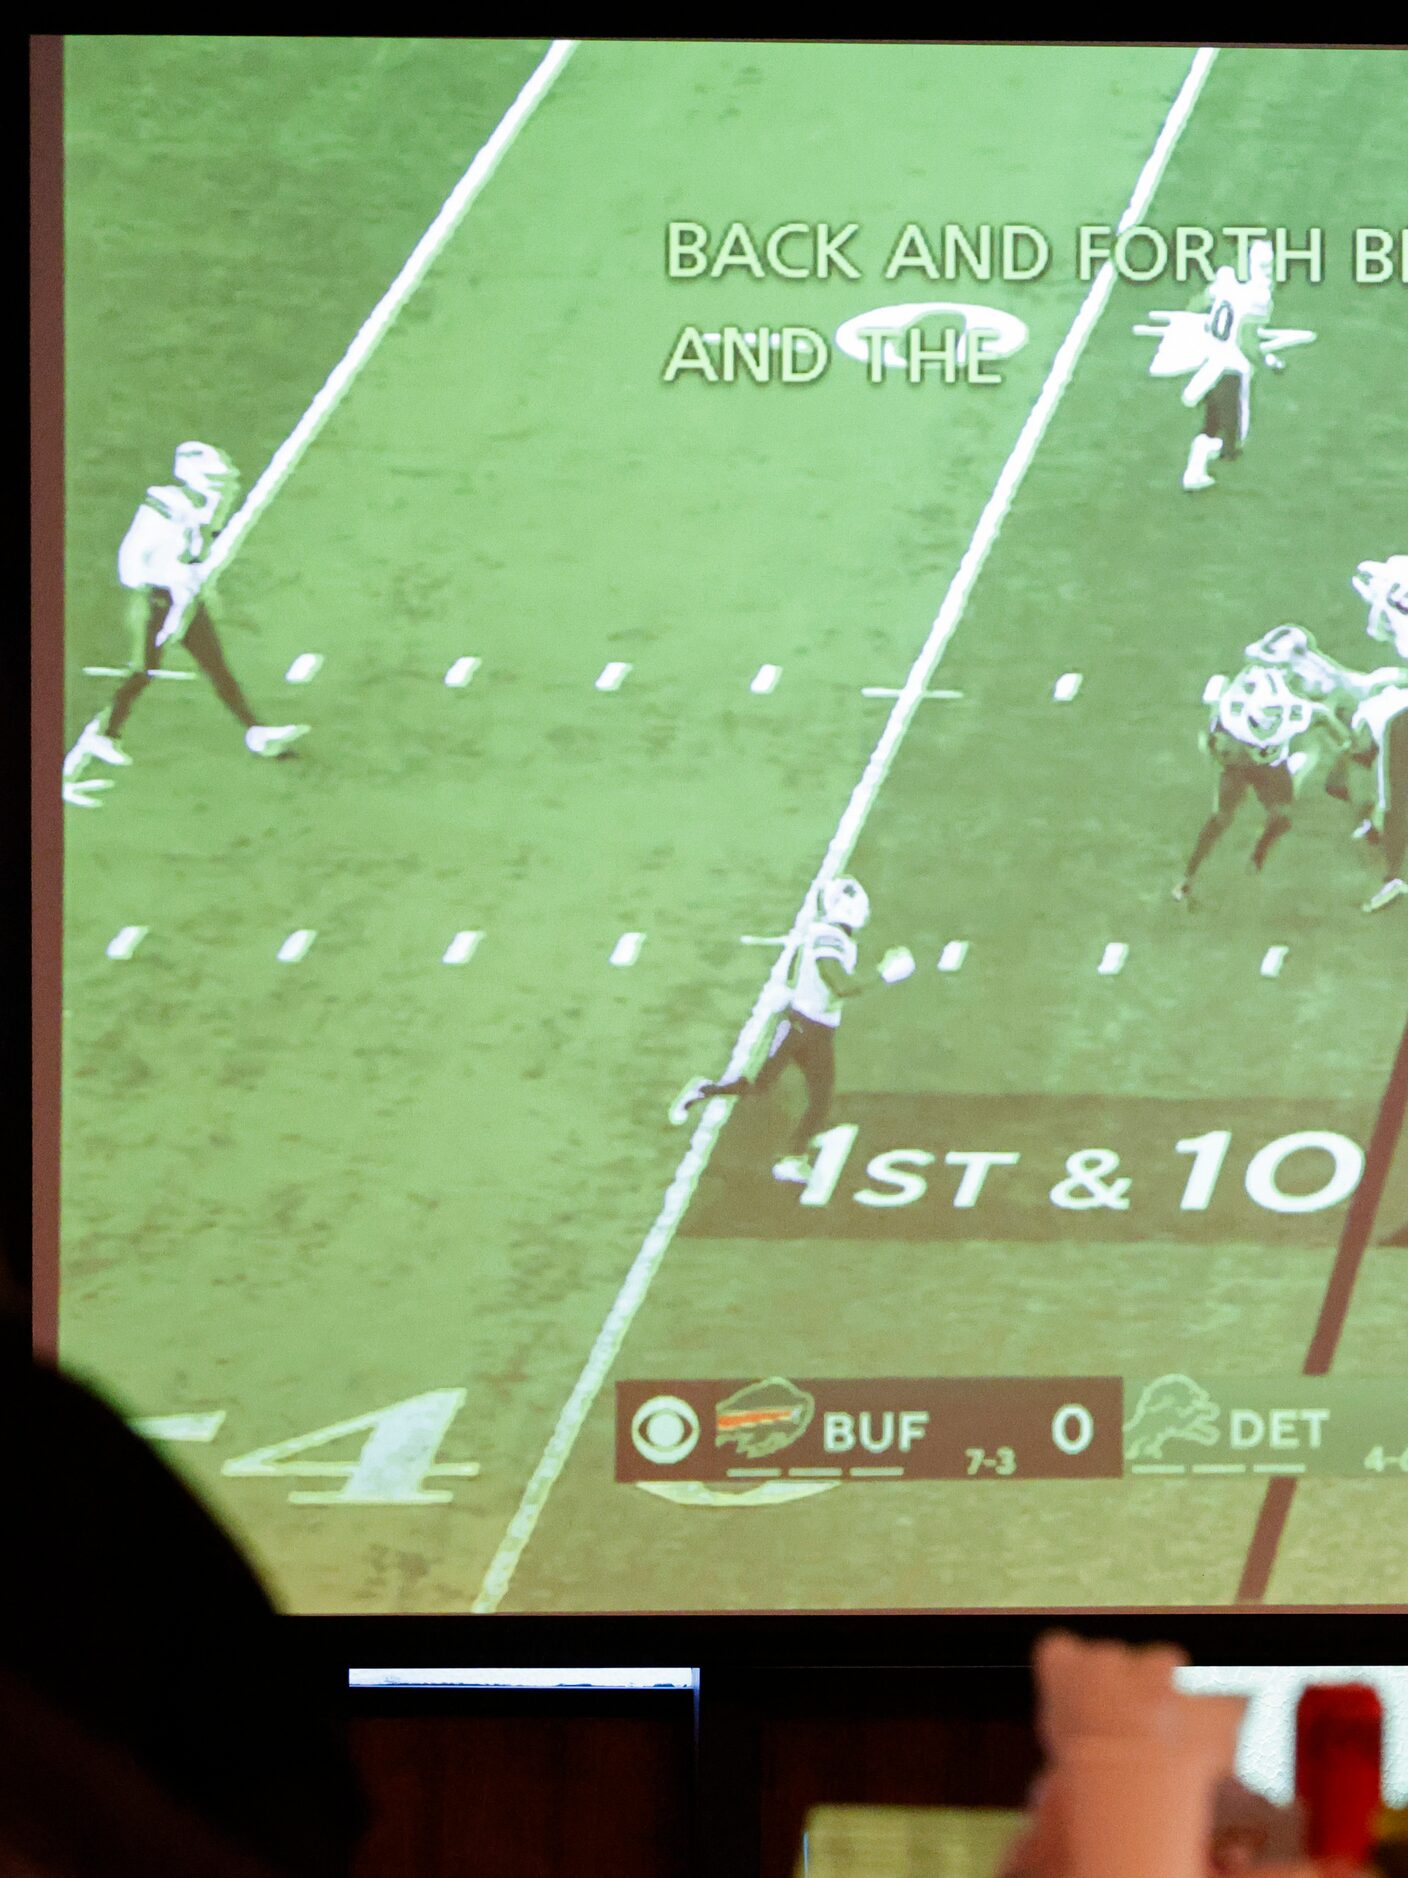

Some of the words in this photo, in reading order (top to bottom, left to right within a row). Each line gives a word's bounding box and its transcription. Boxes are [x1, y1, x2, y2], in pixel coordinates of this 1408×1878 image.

[667, 220, 862, 279] BACK
[885, 223, 1050, 281] AND
[1079, 225, 1326, 284] FORTH
[663, 326, 830, 384] AND
[866, 326, 1002, 385] THE
[797, 1123, 1021, 1209] 1ST
[1048, 1148, 1133, 1212] &
[1174, 1129, 1366, 1214] 10
[823, 1411, 930, 1454] BUF
[1051, 1403, 1095, 1456] 0
[1229, 1408, 1331, 1450] DET
[966, 1447, 1018, 1478] 7-3
